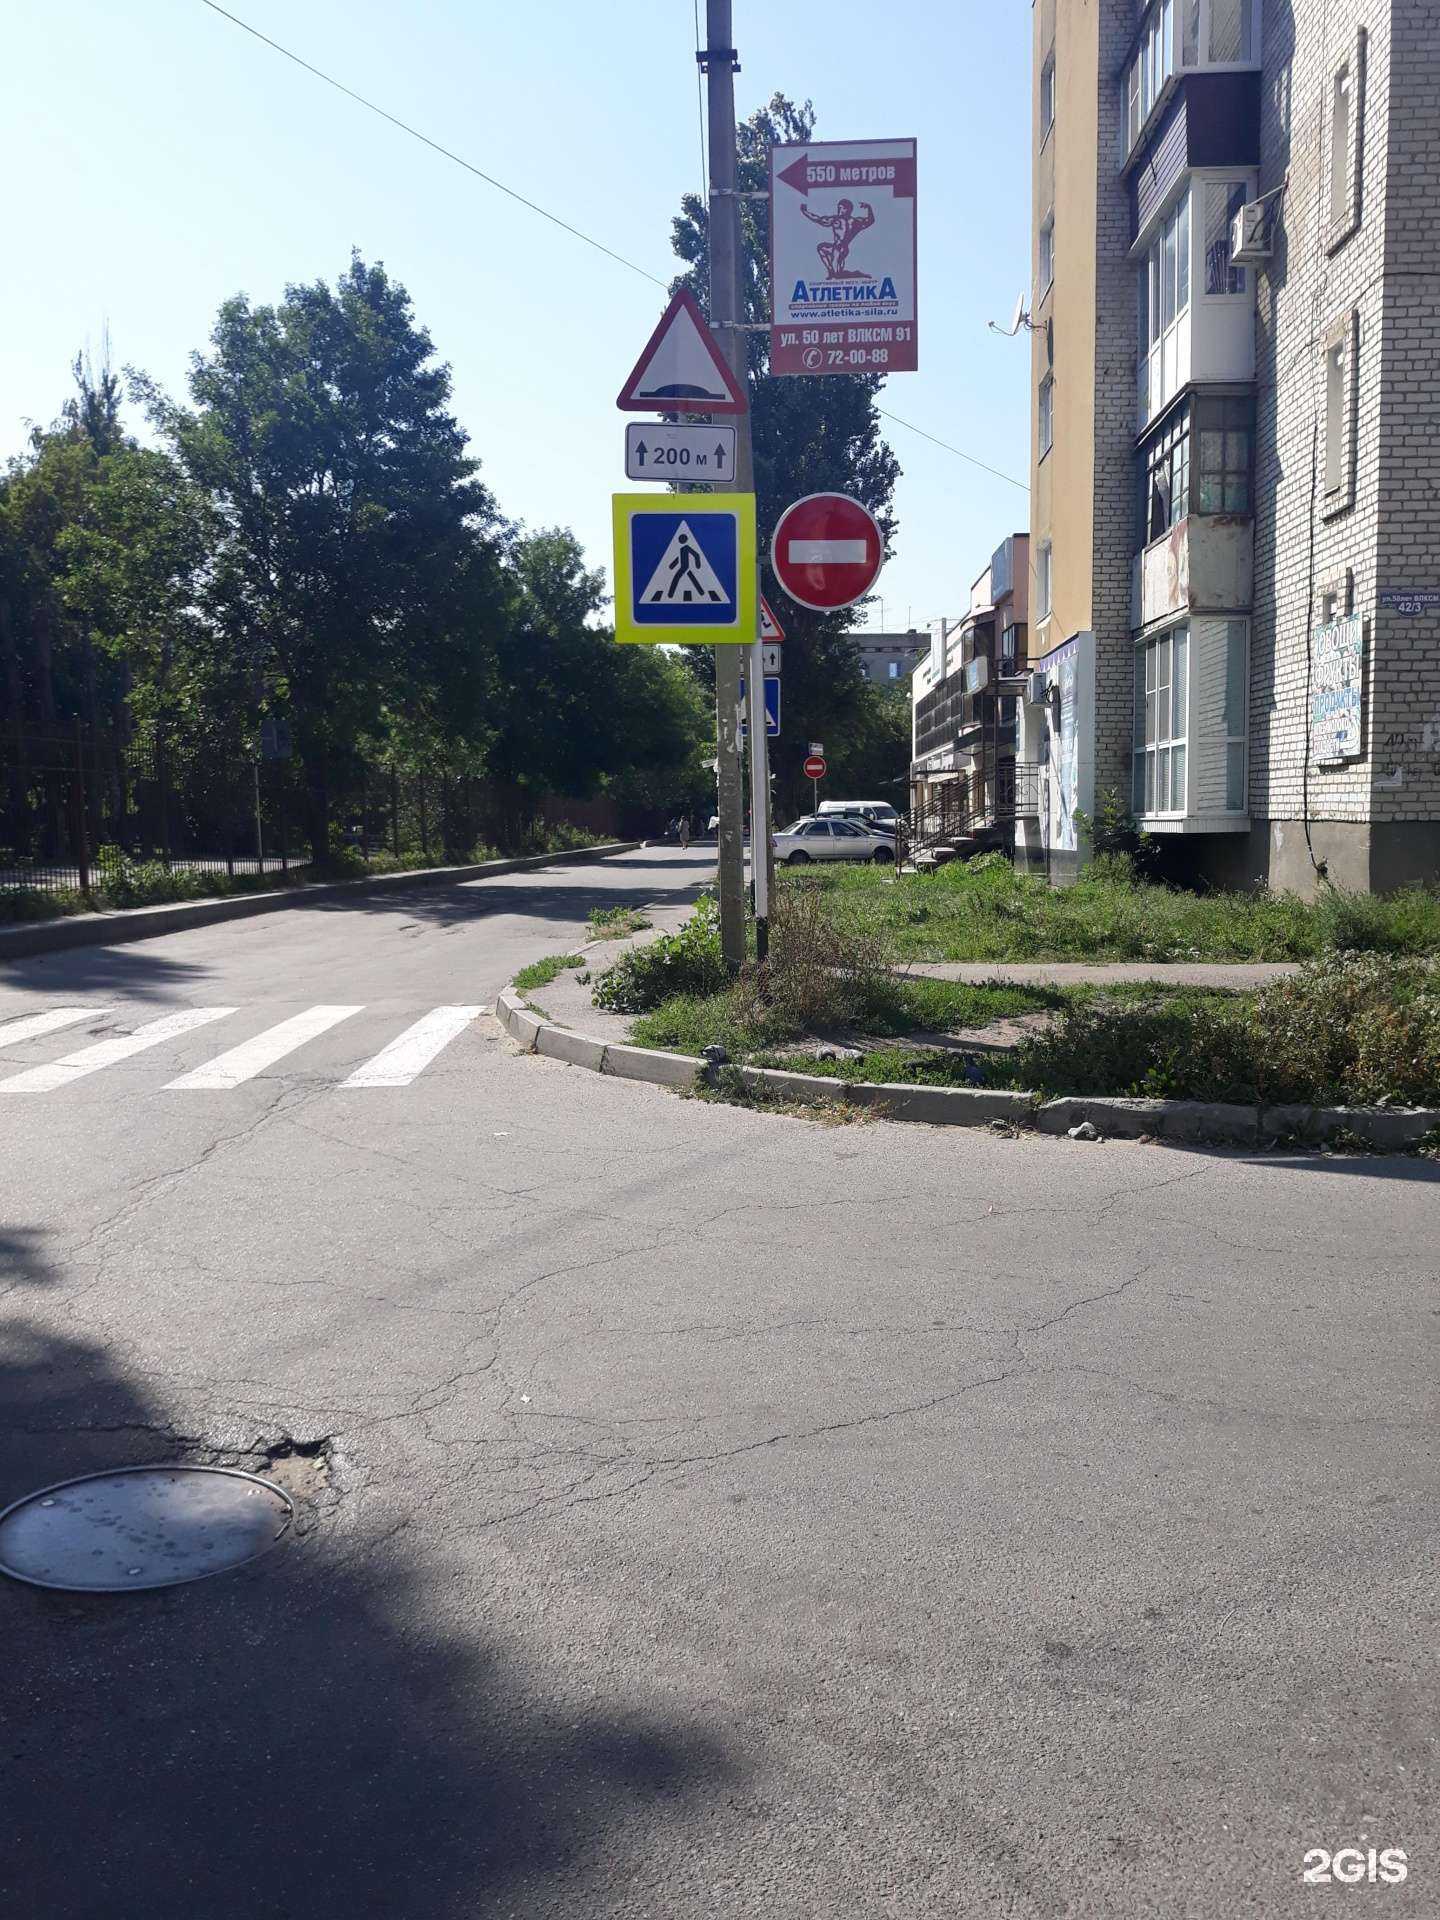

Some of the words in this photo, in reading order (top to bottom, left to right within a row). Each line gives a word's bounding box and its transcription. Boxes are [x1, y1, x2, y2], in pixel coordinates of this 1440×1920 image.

[806, 166, 836, 183] 550
[839, 165, 896, 181] метров
[790, 307, 898, 319] www.atletika-sila.ru
[780, 331, 799, 346] ул.
[802, 330, 819, 344] 50
[822, 331, 844, 344] лет
[847, 328, 893, 343] ВЛКСМ
[895, 327, 912, 342] 91
[826, 349, 889, 365] 72-00-88
[653, 448, 691, 465] 200
[1398, 602, 1422, 612] 42/3
[1318, 621, 1360, 656] ОВОЩИ
[1314, 653, 1361, 687] ФРУКТЫ
